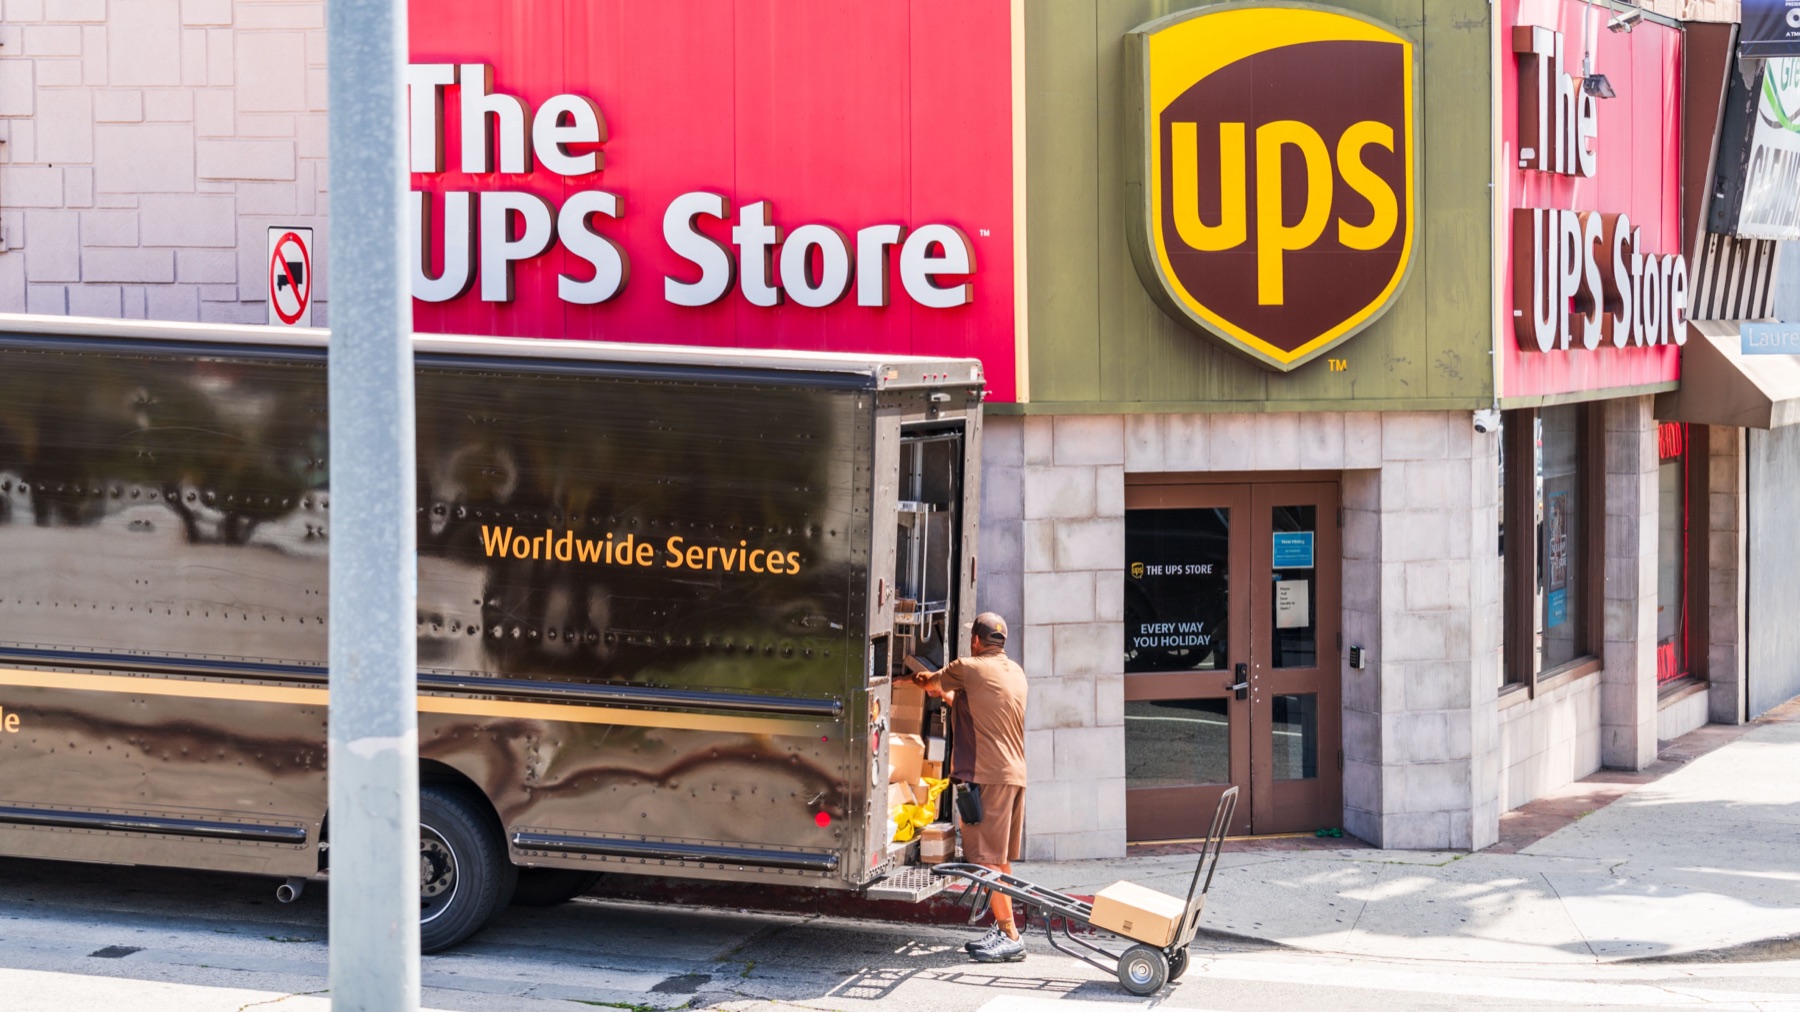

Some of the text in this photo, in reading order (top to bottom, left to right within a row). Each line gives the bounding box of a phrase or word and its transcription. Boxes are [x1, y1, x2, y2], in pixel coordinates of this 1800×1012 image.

[409, 63, 605, 176] The
[1532, 25, 1597, 178] The
[1171, 120, 1398, 306] ups
[411, 190, 990, 308] UPS Store TM
[1533, 207, 1688, 353] UPS Store
[1749, 327, 1800, 347] Laure
[1328, 359, 1347, 372] TM
[481, 525, 800, 575] Worldwide Services
[1146, 564, 1213, 576] THE UPS STORE
[1133, 635, 1211, 647] YOU HOLIDAY
[1141, 622, 1204, 634] EVERY WAY
